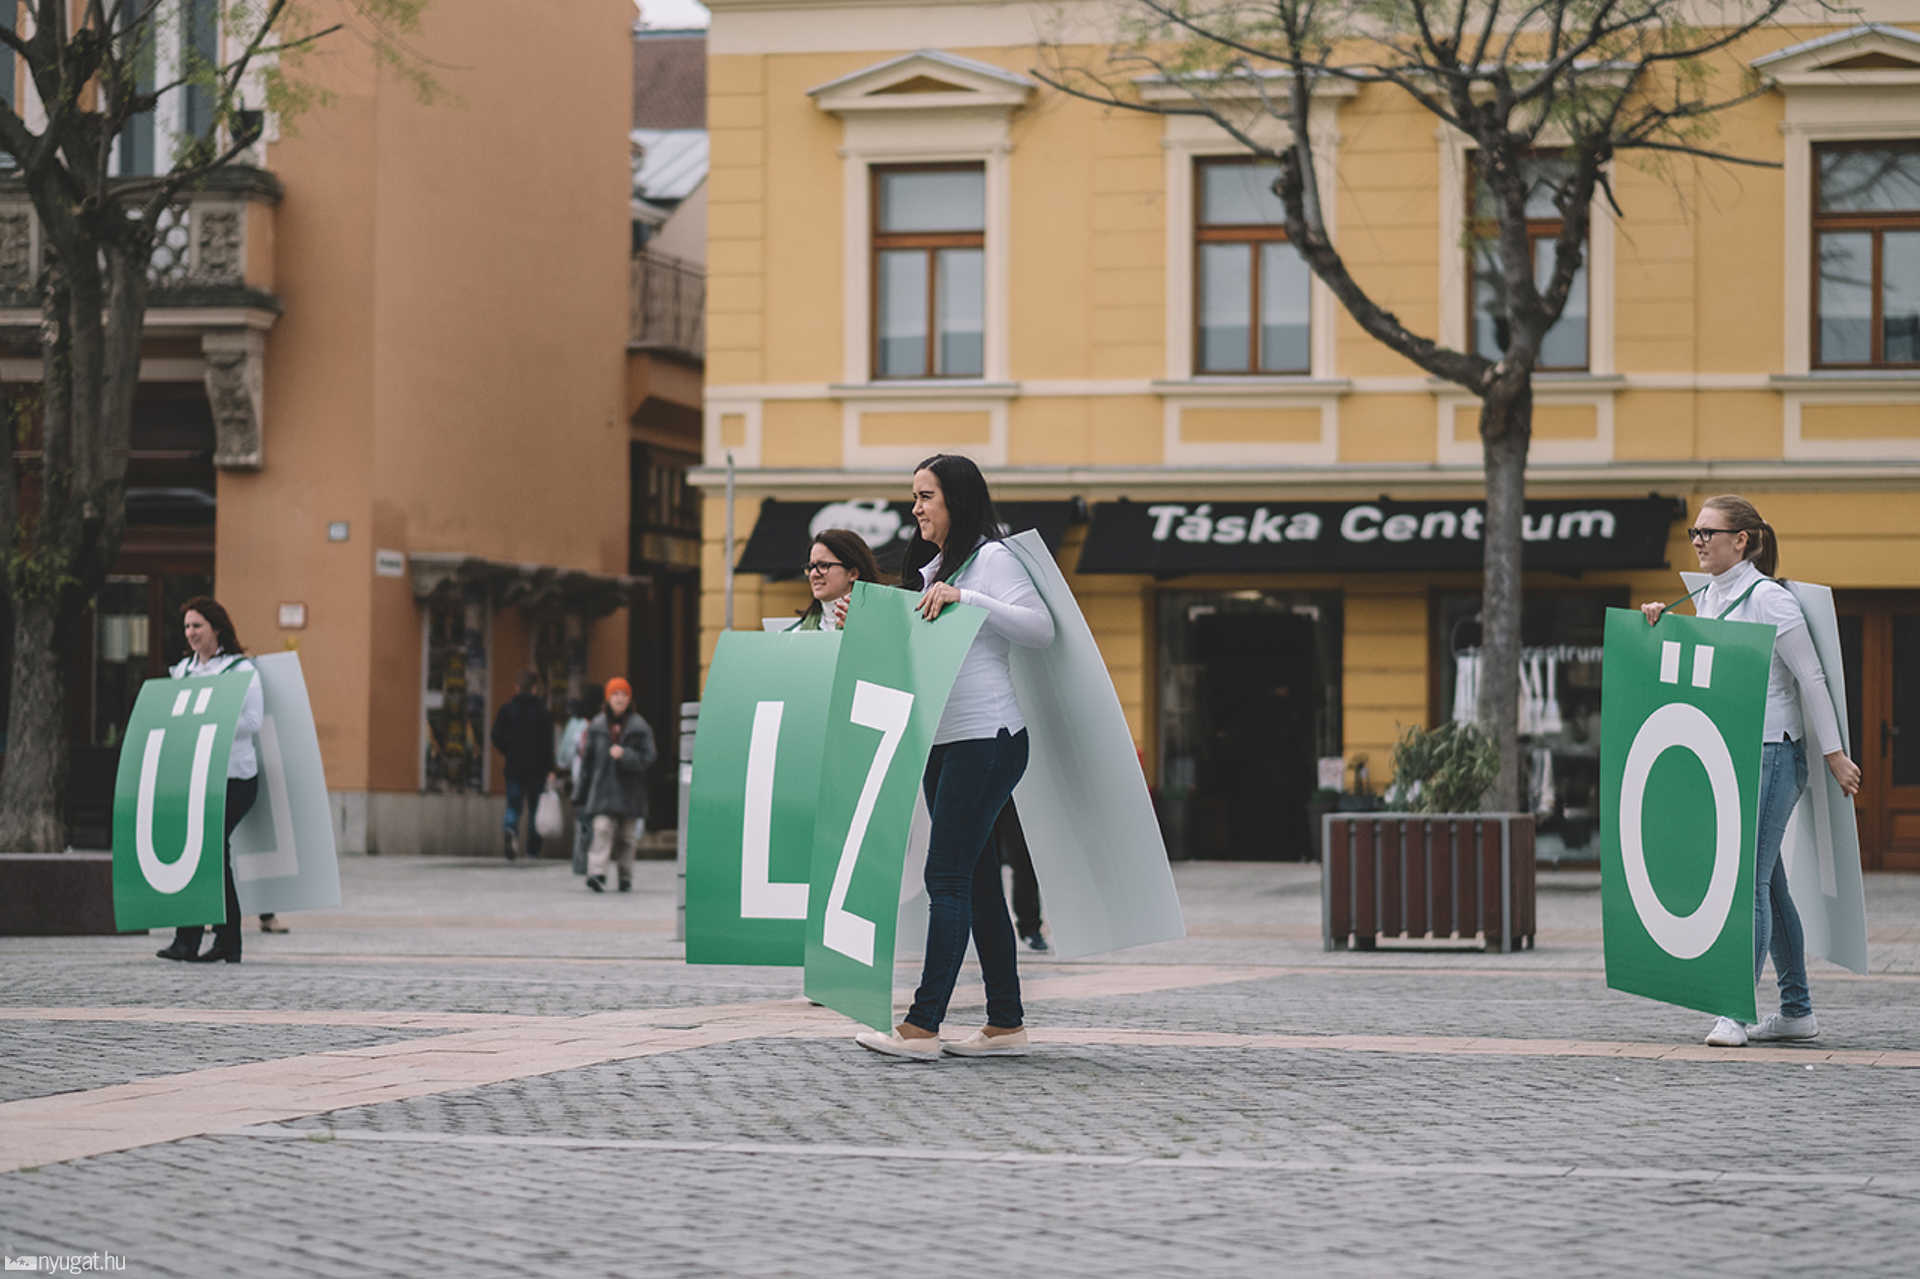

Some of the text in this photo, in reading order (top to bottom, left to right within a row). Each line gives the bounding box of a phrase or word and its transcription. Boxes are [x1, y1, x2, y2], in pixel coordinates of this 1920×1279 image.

[1148, 504, 1615, 543] Táska Centum
[136, 687, 217, 894] Ü
[740, 700, 811, 919] L
[823, 679, 914, 967] Z
[1620, 639, 1742, 960] Ö
